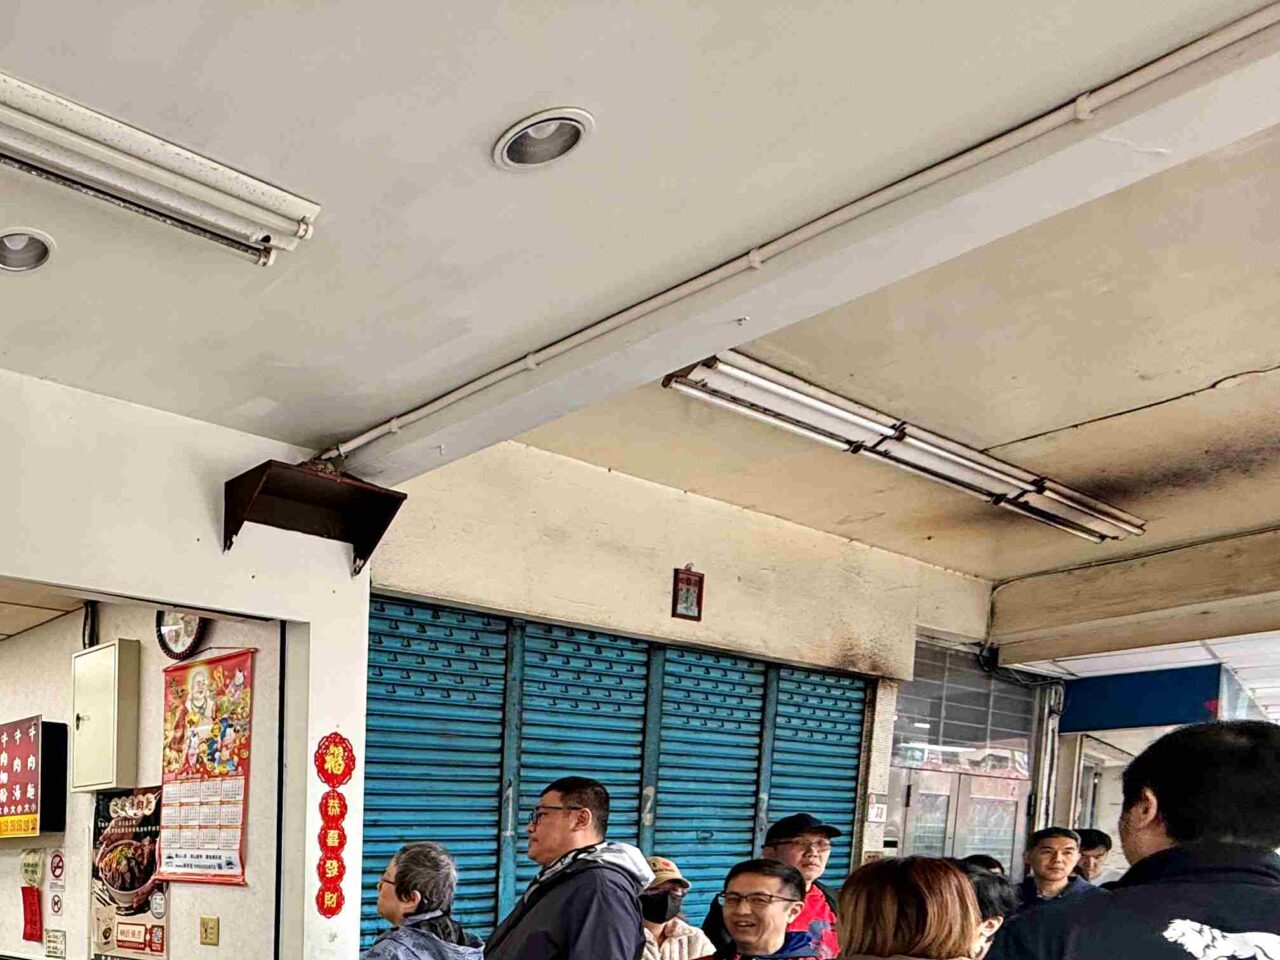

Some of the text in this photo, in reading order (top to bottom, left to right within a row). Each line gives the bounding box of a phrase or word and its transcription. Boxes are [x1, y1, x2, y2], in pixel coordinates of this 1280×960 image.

[12, 728, 22, 801] 牛肉湯
[26, 725, 36, 800] 牛肉麵
[324, 744, 346, 775] 福
[323, 798, 342, 909] 恭喜發財
